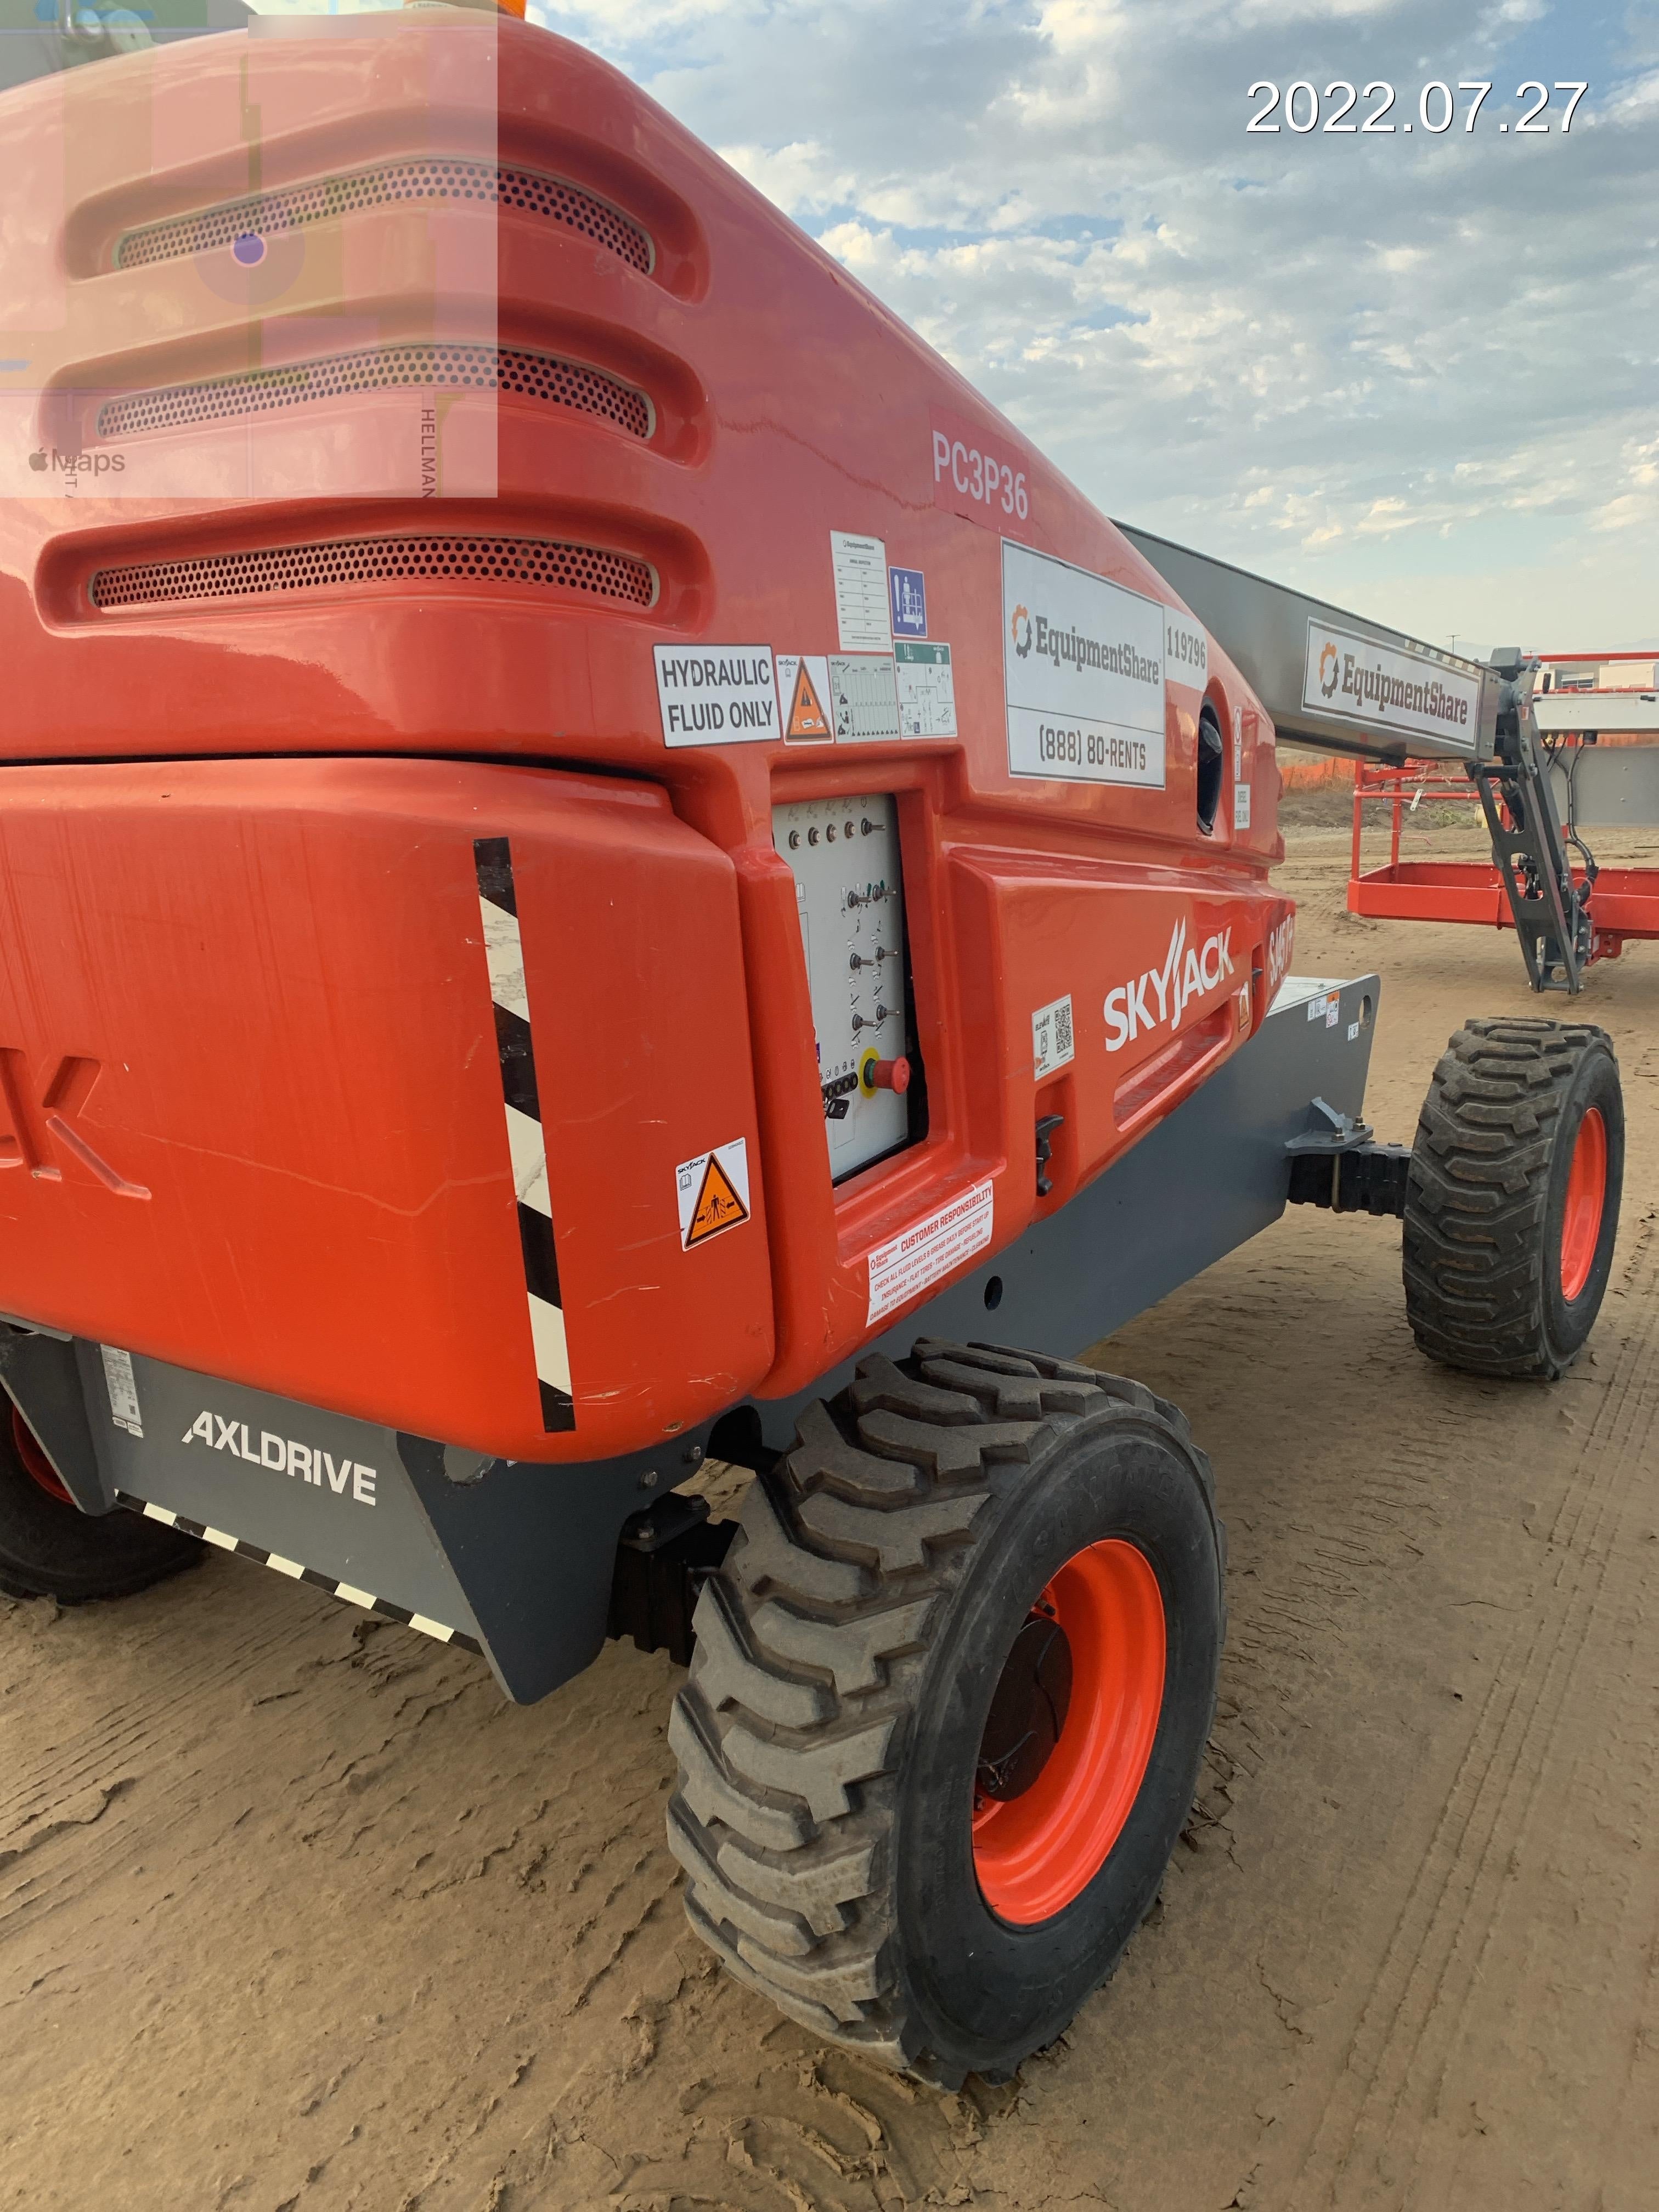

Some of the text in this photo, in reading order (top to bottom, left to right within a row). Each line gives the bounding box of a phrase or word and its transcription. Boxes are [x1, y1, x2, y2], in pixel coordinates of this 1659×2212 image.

[933, 431, 1028, 520] PC3P36
[662, 658, 769, 687] HYDRAULIC
[1035, 616, 1160, 685] EquipmentShare
[1167, 626, 1206, 670] 119796
[667, 701, 773, 732] FLUID ONLY
[1342, 654, 1468, 724] EquipmentShare
[1040, 724, 1147, 770] (888) 80-RENTS
[1103, 915, 1235, 1052] SKYJACK
[678, 1158, 706, 1173] SKYJACK
[874, 1276, 889, 1291] CHECK
[899, 1263, 911, 1276] FLUID
[912, 1253, 926, 1267] LEVELS
[930, 1239, 946, 1255] GREASE
[946, 1232, 957, 1244] DAILY
[958, 1223, 972, 1236] BEFORE
[972, 1215, 983, 1227] START
[901, 1186, 992, 1252] CUSTOMER RESPONSIBILITY
[870, 1304, 889, 1321] DAMAGE
[896, 1281, 921, 1303] EQUIPMENT
[924, 1267, 941, 1285] BATTERY
[942, 1249, 969, 1272] MAINTENANCE
[972, 1235, 989, 1251] CLEANING
[881, 1228, 983, 1301] INSURANCE FLAT TIRES TIRE DAMAGE REFUELING
[181, 1410, 376, 1506] AXLDRIVE
